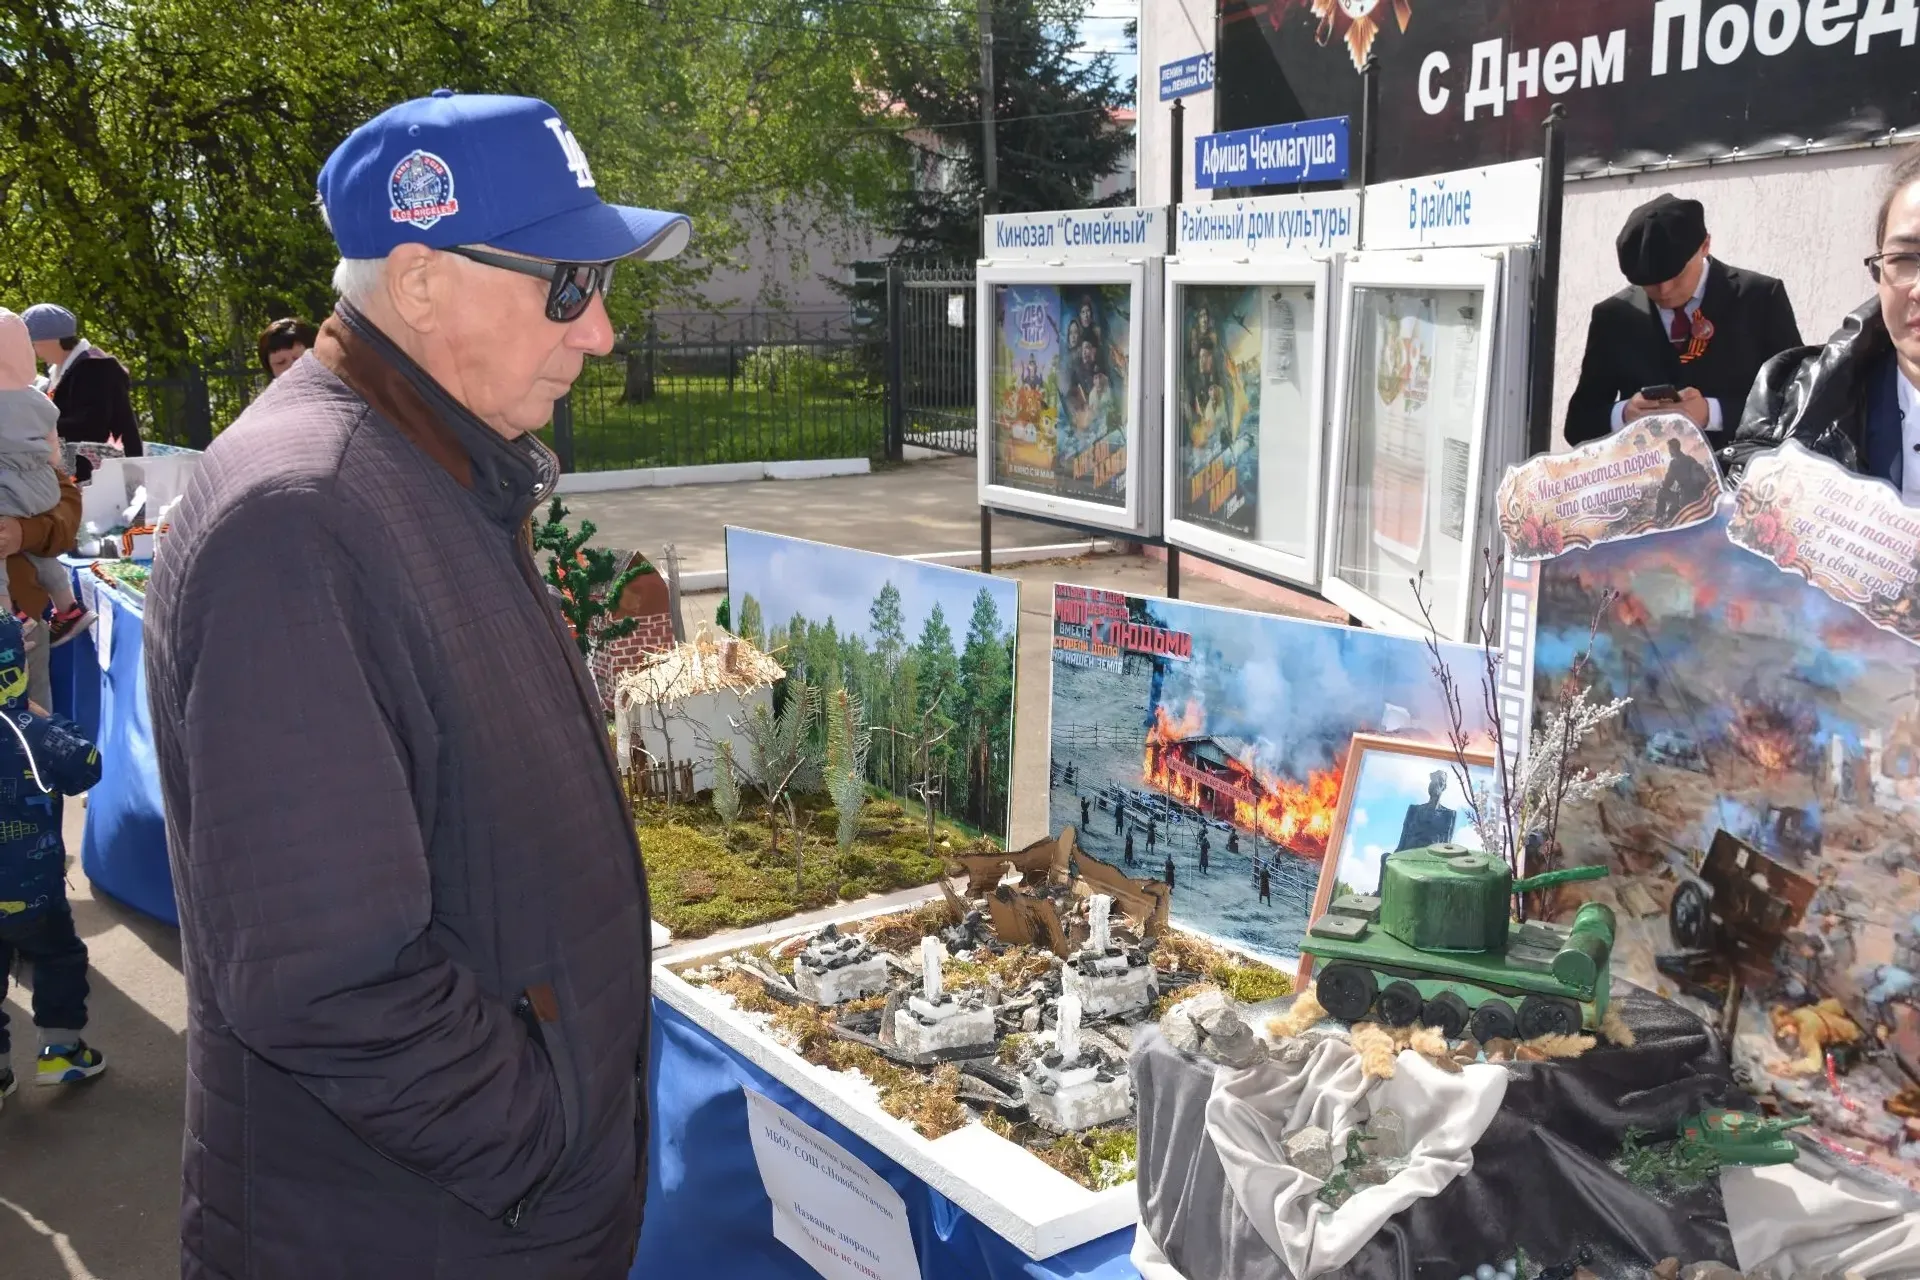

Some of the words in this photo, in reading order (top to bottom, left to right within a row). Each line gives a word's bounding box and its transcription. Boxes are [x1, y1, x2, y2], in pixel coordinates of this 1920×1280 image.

[1465, 29, 1626, 122] Днем
[1202, 138, 1247, 184] Афиша
[1250, 134, 1336, 177] Чекмагуша
[996, 220, 1053, 248] Кинозал
[1058, 210, 1153, 246] "Семейный"
[1181, 203, 1244, 242] Районный
[1248, 211, 1275, 247] дом
[1278, 207, 1352, 248] культуры
[1409, 188, 1417, 229] В
[1420, 180, 1472, 241] районе
[1537, 479, 1564, 500] Мне
[1564, 463, 1621, 493] кажется
[1624, 449, 1665, 475] порою,
[1819, 478, 1854, 507] Нет
[1854, 493, 1869, 512] в
[1555, 500, 1579, 518] что
[1581, 482, 1642, 513] солдаты,
[1813, 503, 1859, 533] семьи
[1793, 517, 1816, 536] где
[1826, 533, 1844, 549] не
[1844, 541, 1916, 583] памятен
[1798, 539, 1826, 564] был
[1826, 556, 1860, 580] свой
[1860, 572, 1902, 599] герой
[1059, 622, 1091, 640] ВМЕСТЕ
[1091, 618, 1104, 645] С
[1109, 620, 1193, 659] ЛЮДЬМИ
[1065, 652, 1094, 669] НАШЕЙ
[765, 1126, 793, 1151] МБОУ
[794, 1145, 820, 1170] СОШ
[793, 1201, 836, 1236] Название
[838, 1232, 881, 1263] диорамы
[841, 1252, 852, 1265] не
